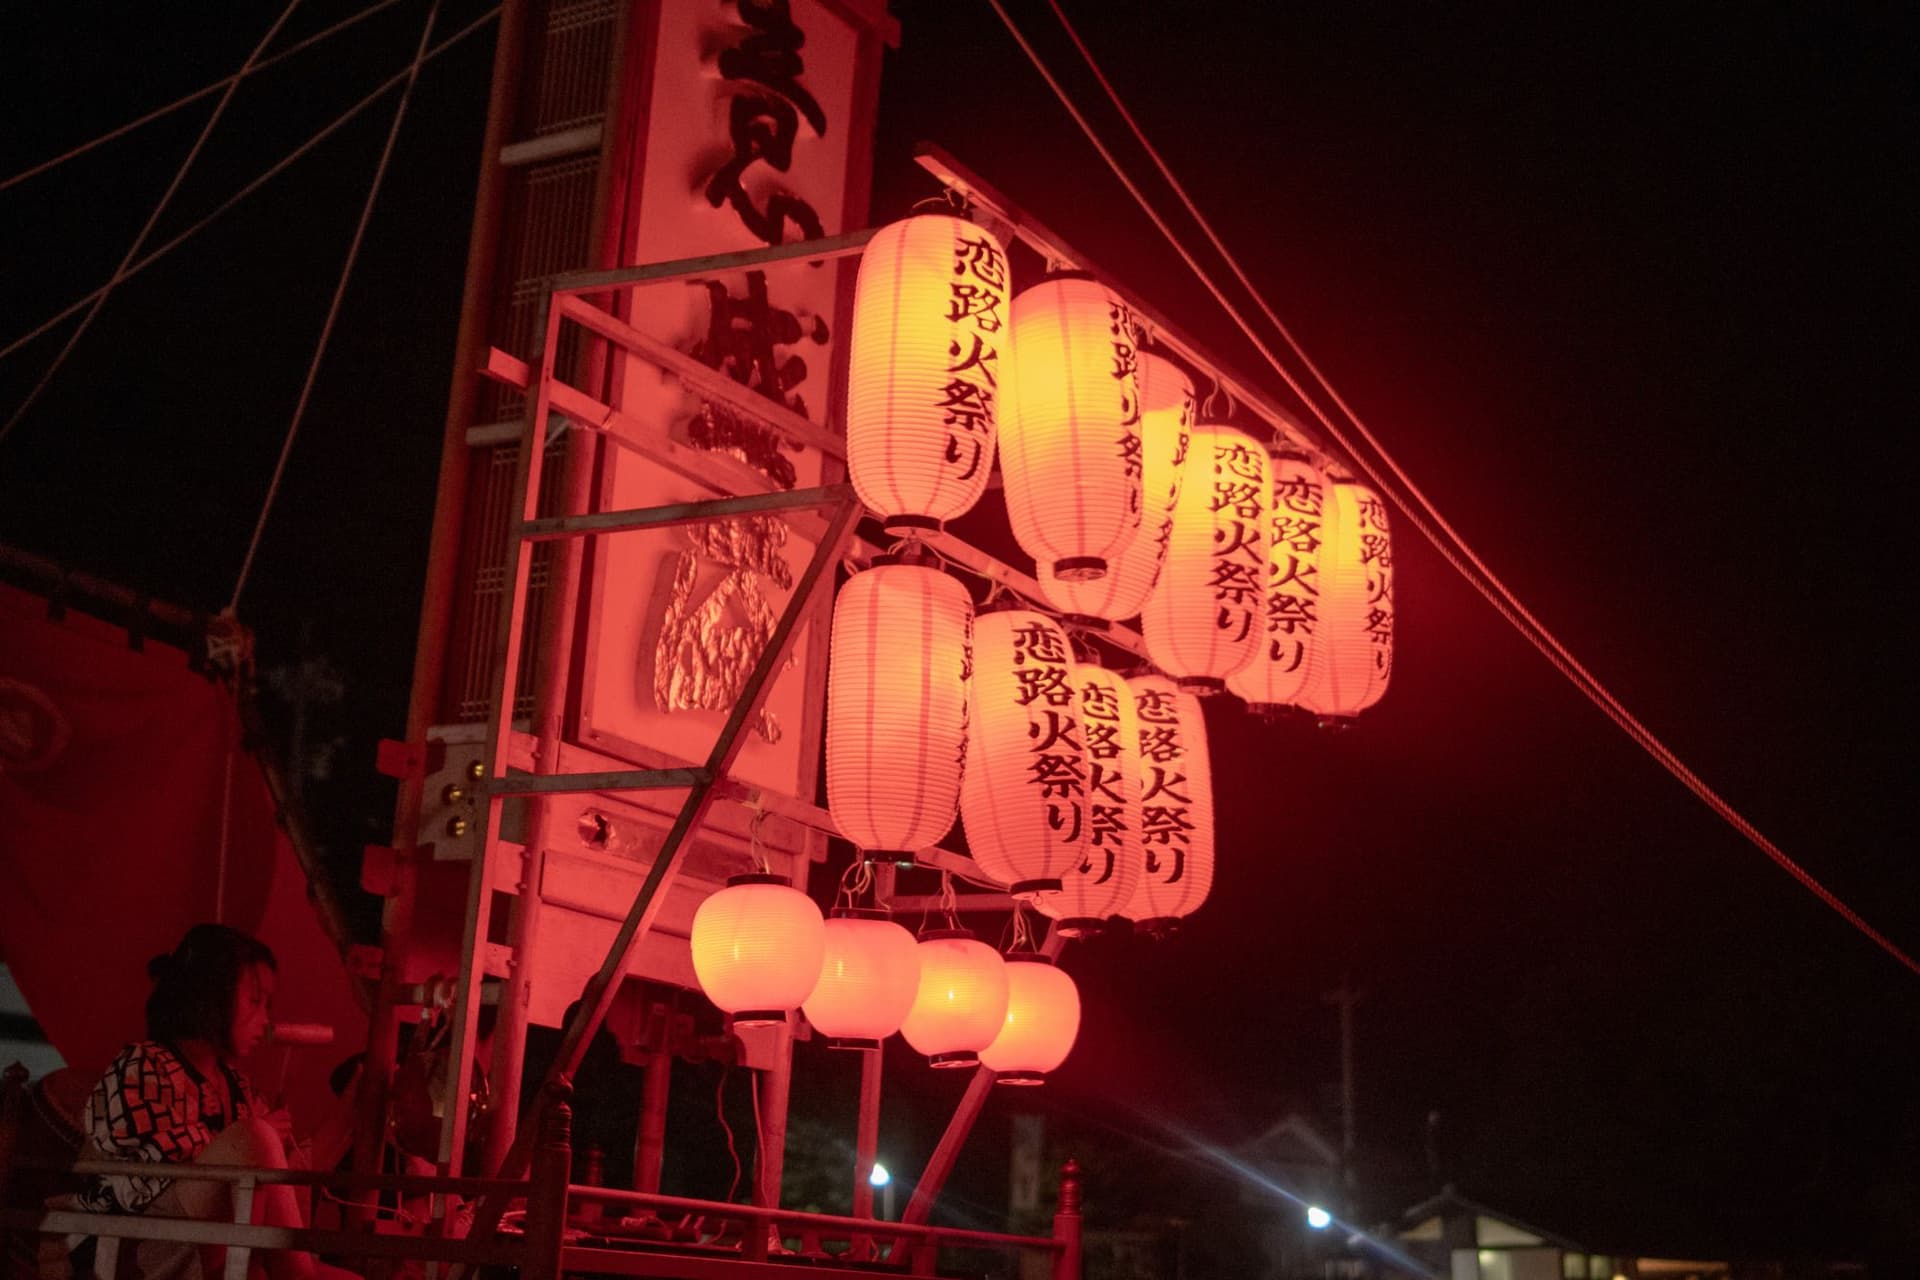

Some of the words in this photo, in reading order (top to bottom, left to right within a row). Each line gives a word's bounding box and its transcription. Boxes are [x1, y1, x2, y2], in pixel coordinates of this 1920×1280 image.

[935, 236, 1004, 481] 恋路火祭り
[1205, 443, 1264, 643] 恋路火祭り
[1267, 475, 1324, 672] 恋路火祭り
[1011, 621, 1087, 843] 恋路火祭り
[1078, 681, 1129, 885] 恋路火祭り
[1134, 688, 1196, 884] 恋路火祭り
